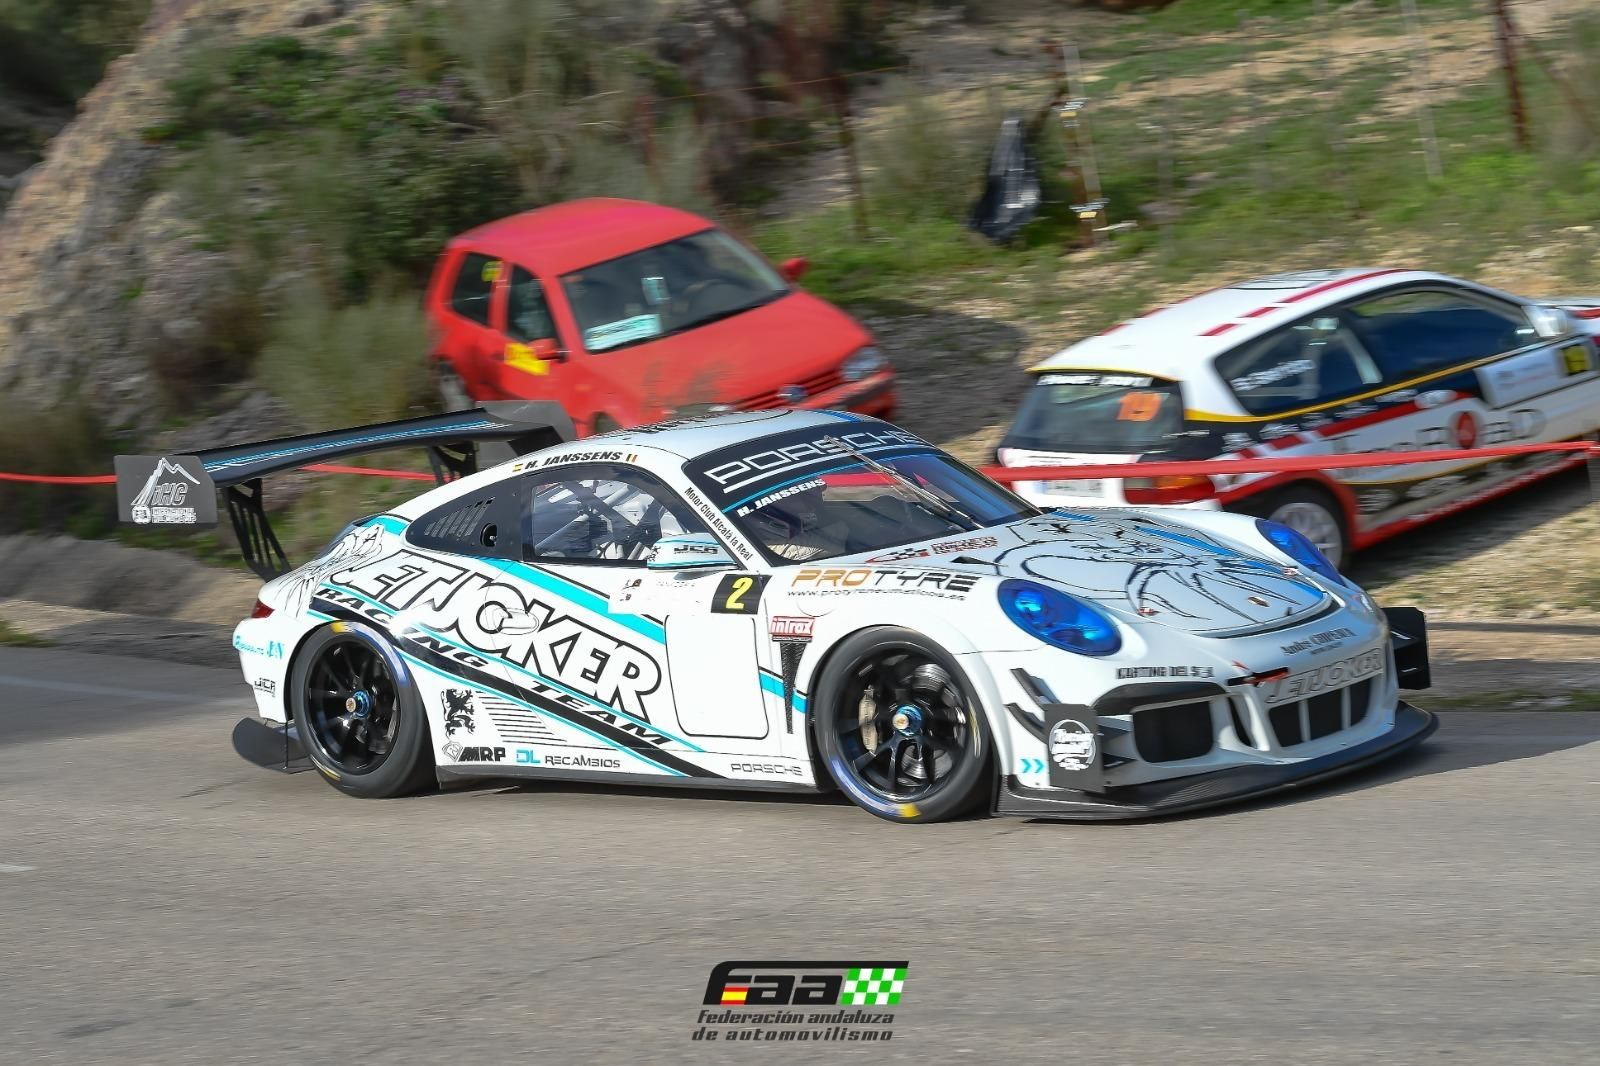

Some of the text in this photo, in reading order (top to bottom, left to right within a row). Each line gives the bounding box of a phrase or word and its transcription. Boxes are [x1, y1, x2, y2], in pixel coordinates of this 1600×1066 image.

[524, 451, 623, 469] H. JANSSENS
[704, 430, 919, 485] PORSCHE
[736, 478, 826, 518] H. JANSSENS
[684, 487, 703, 508] Motor
[700, 503, 716, 521] Club
[735, 543, 754, 561] Real
[725, 577, 753, 610] 2
[791, 569, 982, 592] PROTYRE
[315, 587, 674, 746] RACNG TEAM
[458, 746, 506, 762] MRP
[545, 753, 621, 768] RECAMBIOS
[730, 763, 803, 776] PORSCHE
